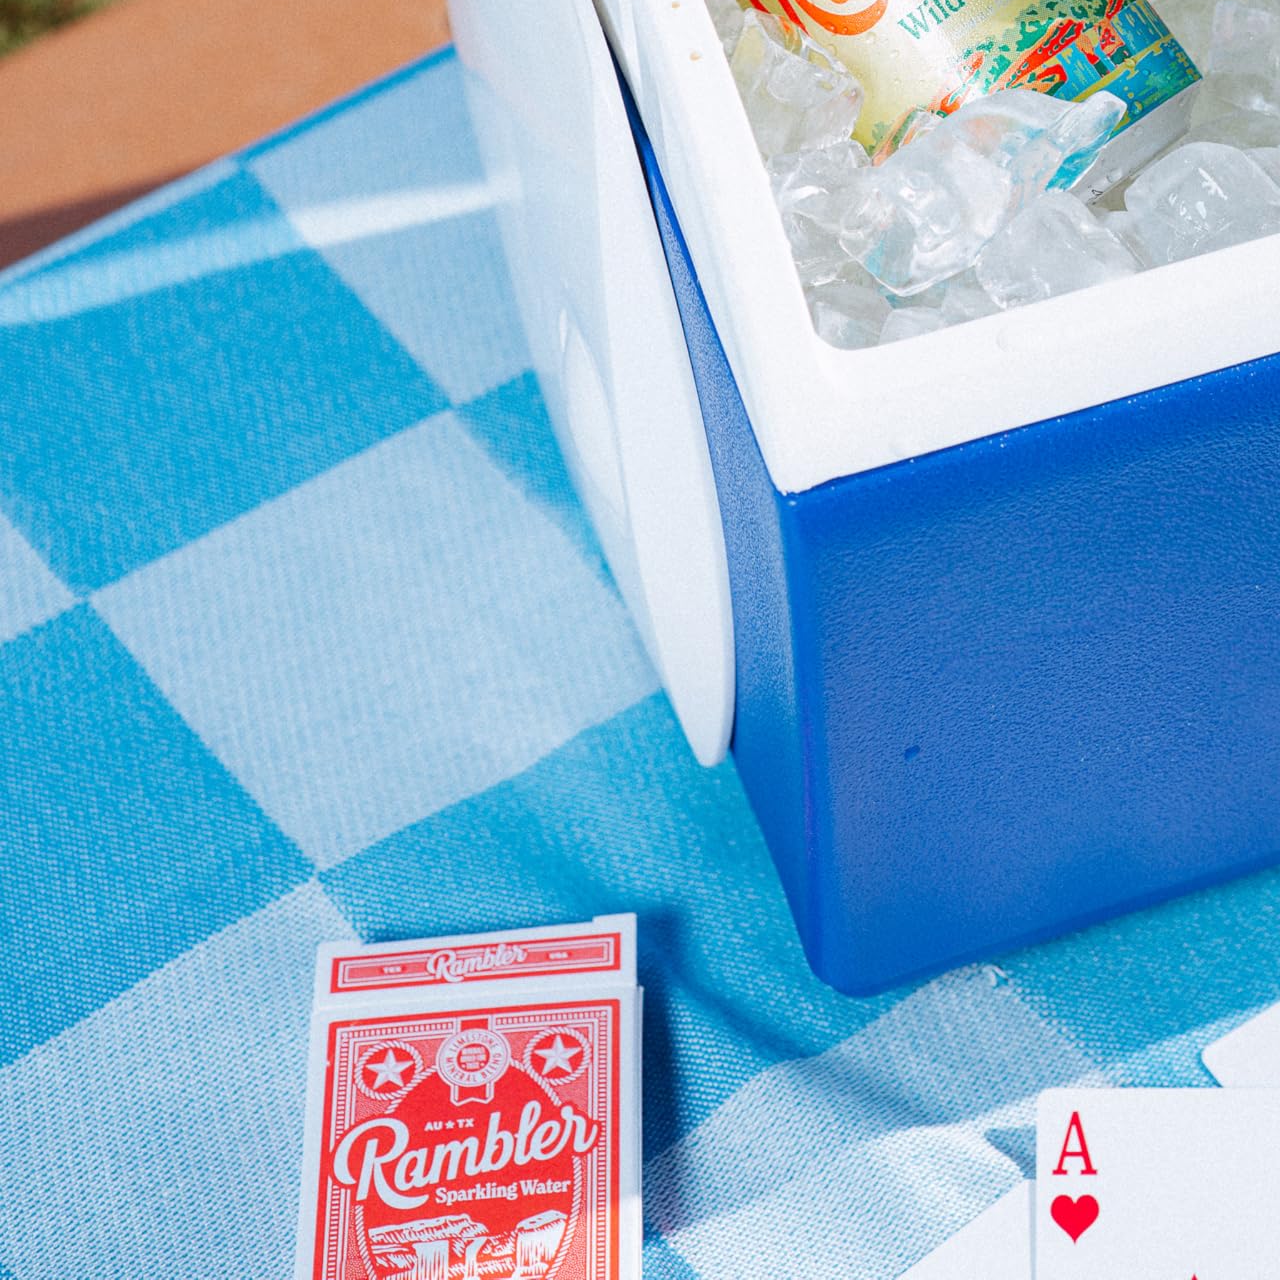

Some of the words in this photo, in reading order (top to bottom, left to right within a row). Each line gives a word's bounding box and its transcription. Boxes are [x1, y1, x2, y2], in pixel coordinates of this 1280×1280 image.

[426, 943, 528, 983] Rambler
[424, 1121, 444, 1131] AU
[456, 1118, 475, 1129] TX
[1052, 1111, 1098, 1175] A
[334, 1100, 598, 1210] Rambler
[435, 1180, 518, 1205] Sparkling
[519, 1178, 571, 1197] Water
